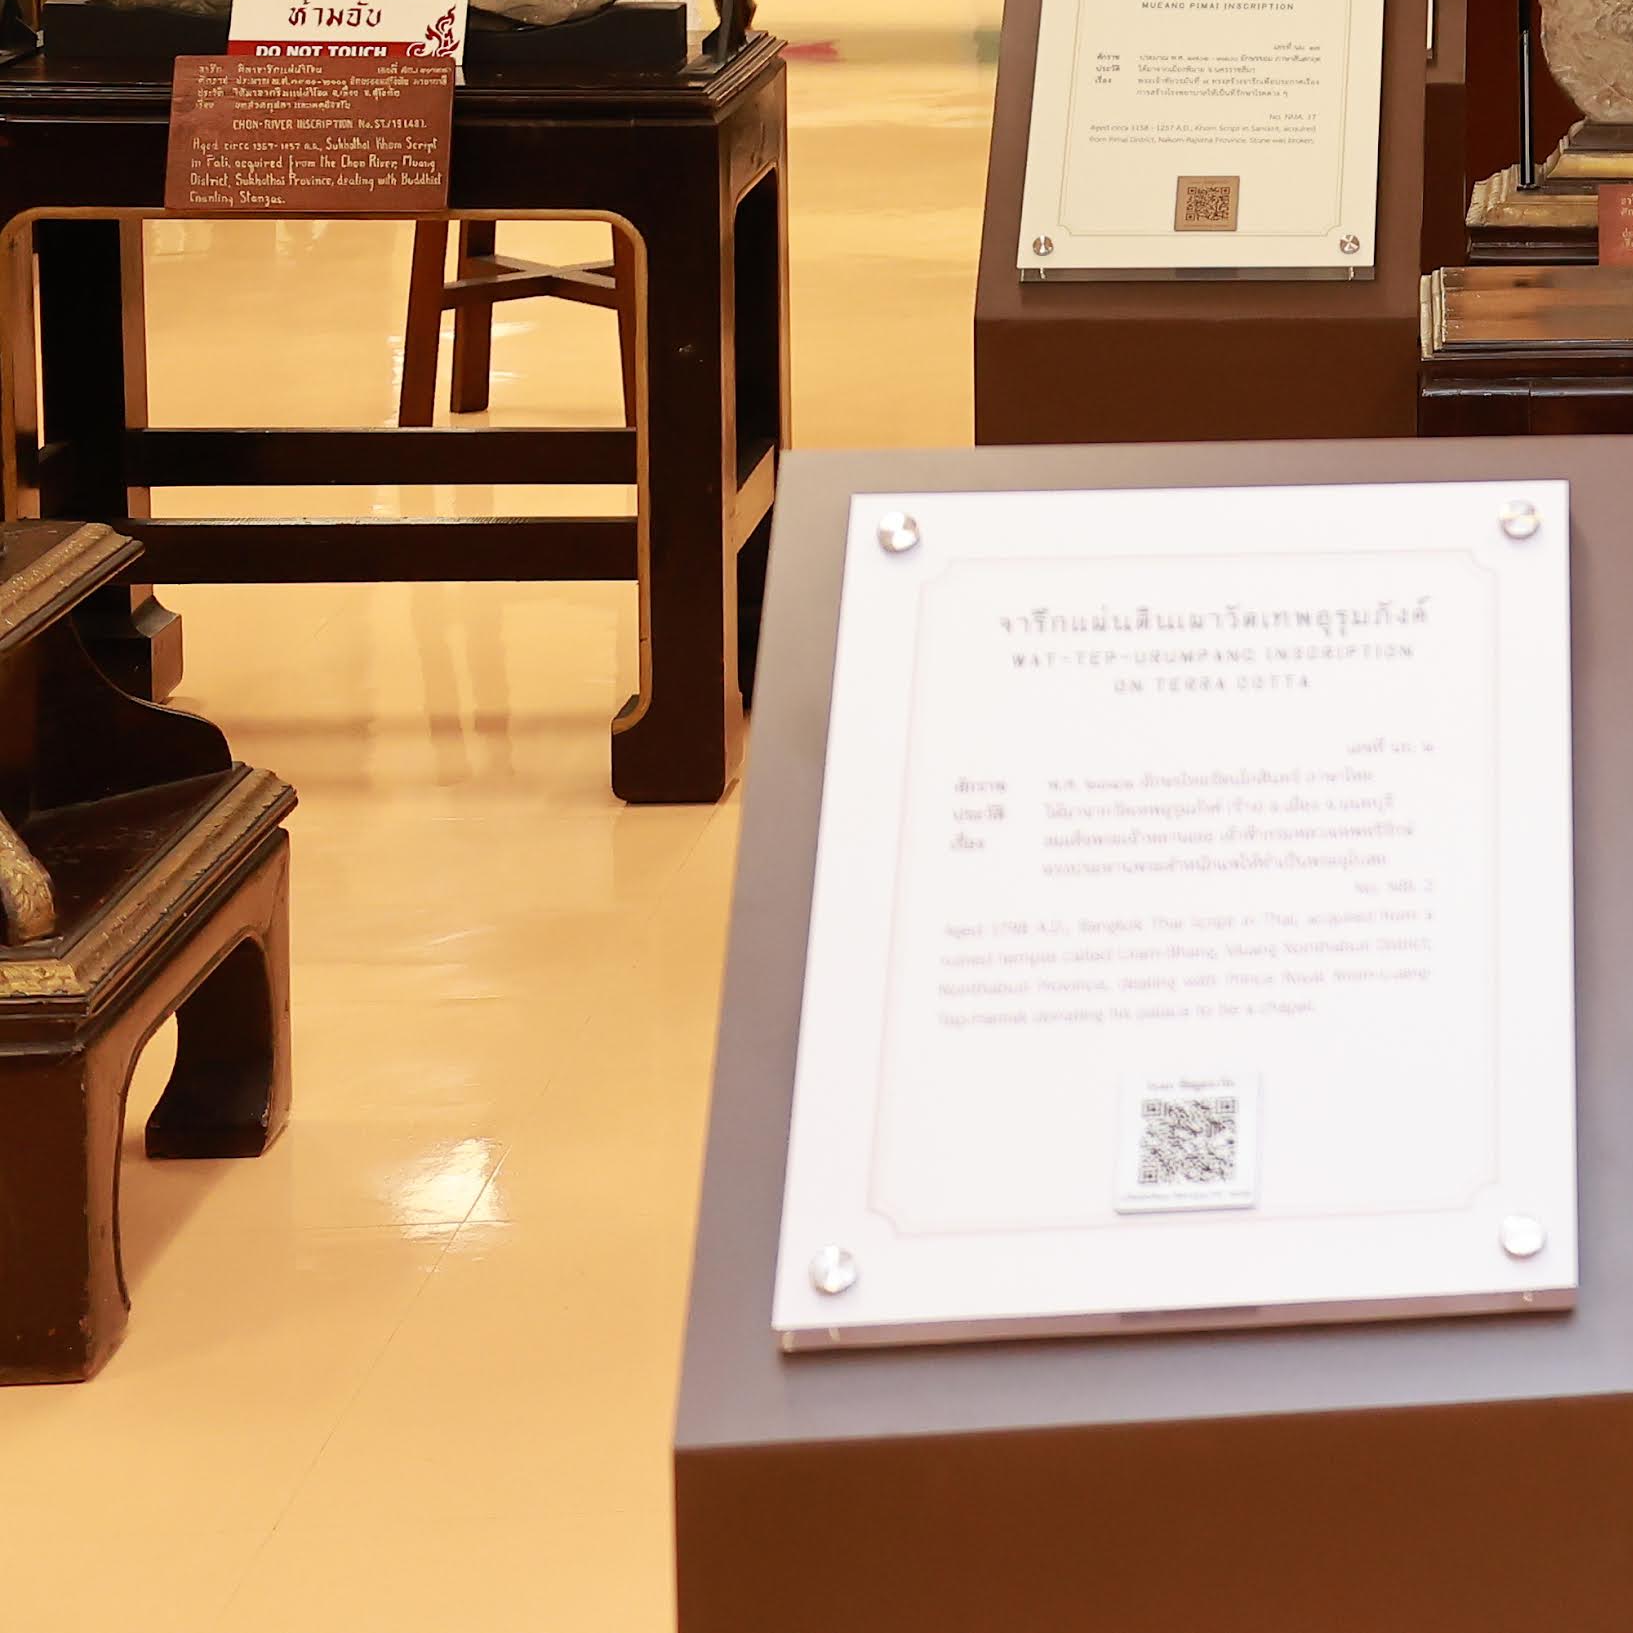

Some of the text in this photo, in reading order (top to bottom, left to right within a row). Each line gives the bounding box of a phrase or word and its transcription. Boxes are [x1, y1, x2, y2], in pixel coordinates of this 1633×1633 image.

[288, 0, 383, 27] ห้ามจับ
[1141, 2, 1185, 10] MUEANG
[1224, 3, 1295, 11] INSCRIPTION
[255, 45, 387, 57] DO NOT TOUCH
[233, 119, 293, 130] CHON-RIVER
[234, 155, 283, 173] acquired
[289, 154, 316, 172] from
[320, 155, 336, 168] the
[377, 173, 397, 186] with
[401, 172, 443, 186] Buddhist
[1264, 644, 1414, 662] INSCRIPTION
[1154, 676, 1225, 693] TERRA
